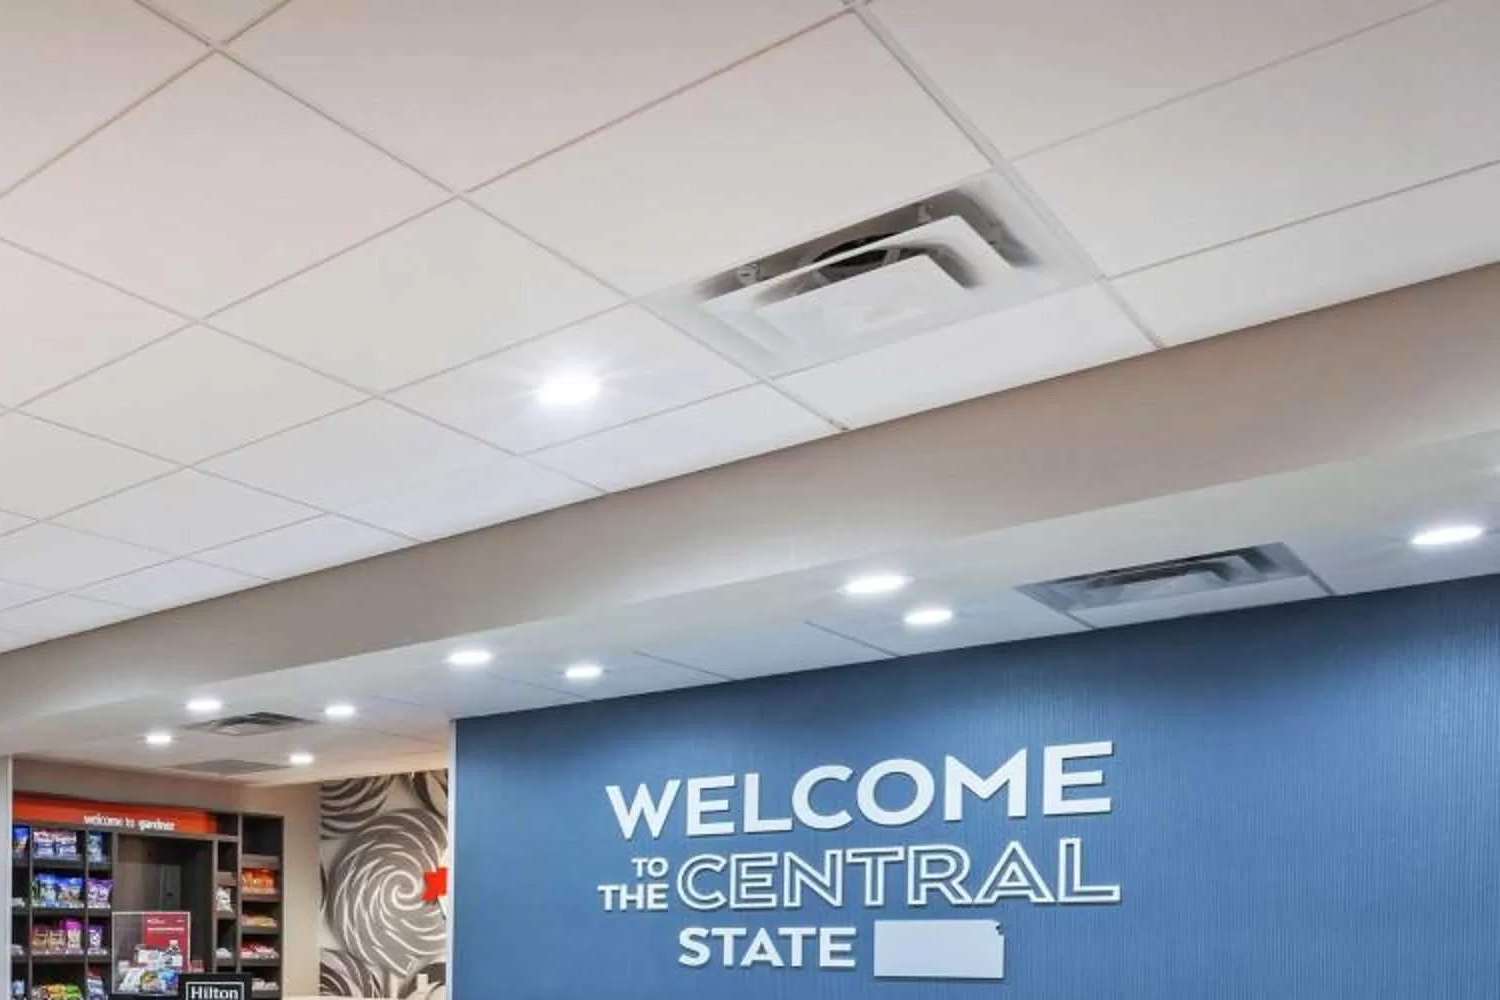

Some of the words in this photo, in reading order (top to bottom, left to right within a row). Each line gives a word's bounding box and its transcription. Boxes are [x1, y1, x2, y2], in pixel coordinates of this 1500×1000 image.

[604, 740, 1115, 840] WELCOME
[83, 812, 123, 827] welcome
[597, 883, 670, 911] THE
[676, 837, 1121, 910] CENTRAL
[631, 856, 669, 878] TO
[678, 926, 857, 968] STATE
[191, 985, 239, 1000] Hilton
